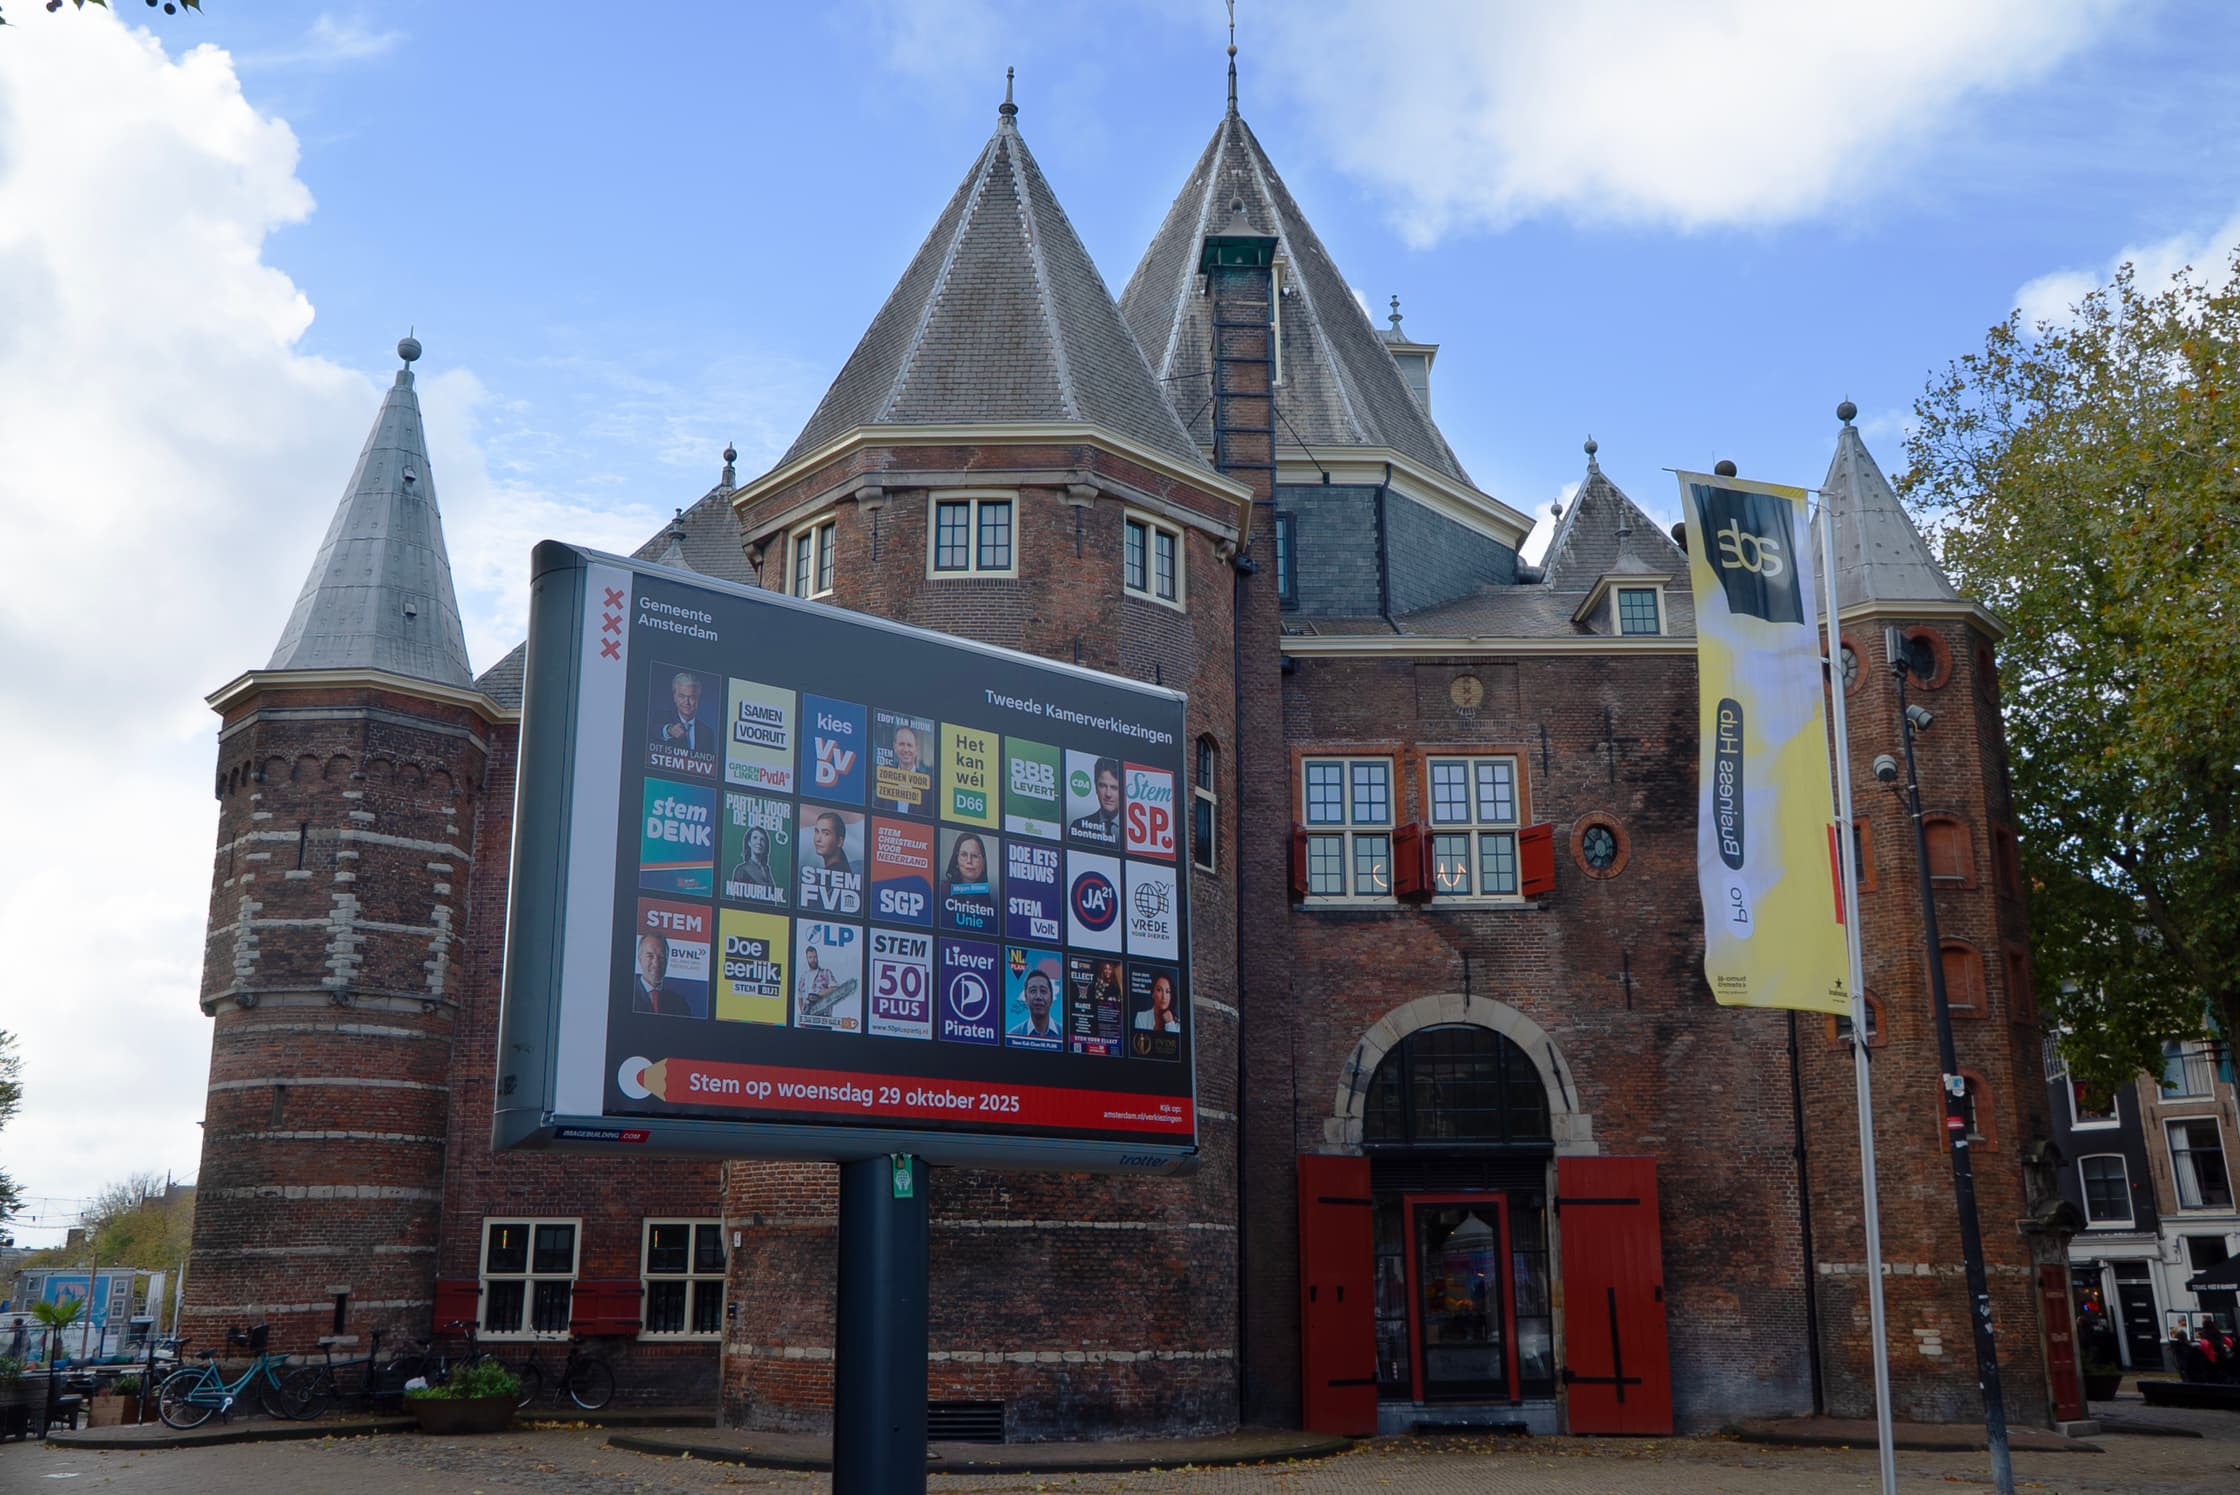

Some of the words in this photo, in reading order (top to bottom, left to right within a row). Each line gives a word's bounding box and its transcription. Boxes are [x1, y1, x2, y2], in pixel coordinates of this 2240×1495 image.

[639, 597, 712, 624] Gemeente
[638, 613, 718, 641] Amsterdam
[744, 704, 782, 723] SAMEN
[877, 712, 894, 725] EDDY
[895, 716, 910, 728] VAN
[985, 689, 1042, 714] Tweede
[1045, 703, 1173, 745] Kamerverkiezingen
[817, 712, 853, 735] kies
[740, 724, 786, 745] VOORUIT
[956, 734, 985, 753] Het
[649, 743, 664, 753] DIT
[664, 744, 673, 754] IS
[673, 747, 689, 758] UW
[690, 750, 715, 761] LAND!
[815, 737, 856, 786] VVD
[877, 747, 893, 758] STEM
[956, 752, 984, 770] kan
[651, 754, 685, 770] STEM
[687, 760, 713, 774] PVV
[729, 762, 760, 775] GROEN
[1011, 758, 1055, 786] BBB
[734, 770, 759, 782] LINKS
[760, 768, 786, 787] PvdA
[879, 769, 907, 784] ZORGEN
[908, 774, 929, 788] VOOR
[956, 771, 984, 788] wél
[1072, 778, 1090, 790] CDA
[879, 784, 920, 802] ZEKERHEID!
[1125, 772, 1172, 801] Stem
[652, 796, 708, 822] stem
[726, 793, 763, 815] PARTIJ
[764, 799, 791, 819] VOOR
[956, 794, 984, 812] D66
[733, 809, 747, 827] DE
[748, 811, 784, 832] DIEREN
[1081, 819, 1105, 832] Henri
[646, 817, 711, 847] DENK
[878, 827, 901, 837] STEM
[1071, 827, 1116, 843] Bontenbal
[878, 836, 928, 850] CHRISTELIJK
[878, 844, 901, 853] VOOR
[877, 852, 927, 867] NEDERLAND
[1008, 844, 1031, 863] DOE
[1032, 847, 1058, 868] IETS
[801, 866, 861, 890] STEM
[1009, 861, 1055, 884] NIEUWS
[726, 880, 787, 905] NATUURLIJK.
[801, 883, 861, 913] FVD
[1082, 886, 1113, 911] JA21
[880, 889, 924, 917] SGP
[945, 898, 994, 917] Christen
[1009, 897, 1042, 918] STEM
[646, 910, 702, 932] STEM
[955, 913, 984, 928] Unie
[1034, 921, 1056, 935] Volt
[1131, 918, 1169, 934] VREDE
[823, 925, 854, 947] LP
[671, 948, 700, 960] BVNL
[726, 935, 762, 957] Doe
[874, 935, 927, 958] STEM
[945, 946, 994, 970] Liever
[1010, 949, 1025, 964] NL
[724, 960, 781, 984] eerlijk.
[878, 964, 922, 998] 50
[734, 983, 757, 993] STEM
[879, 1000, 920, 1016] PLUS
[944, 1020, 994, 1039] Piraten
[689, 1072, 740, 1094] Stem
[745, 1080, 772, 1100] op
[777, 1082, 874, 1107] woensdag
[878, 1086, 901, 1104] 29
[905, 1087, 975, 1110] oktober
[979, 1093, 1020, 1112] 2025
[1103, 1111, 1183, 1124] amsterdam.nl/verkiezingen
[1160, 1104, 1171, 1113] Kijk
